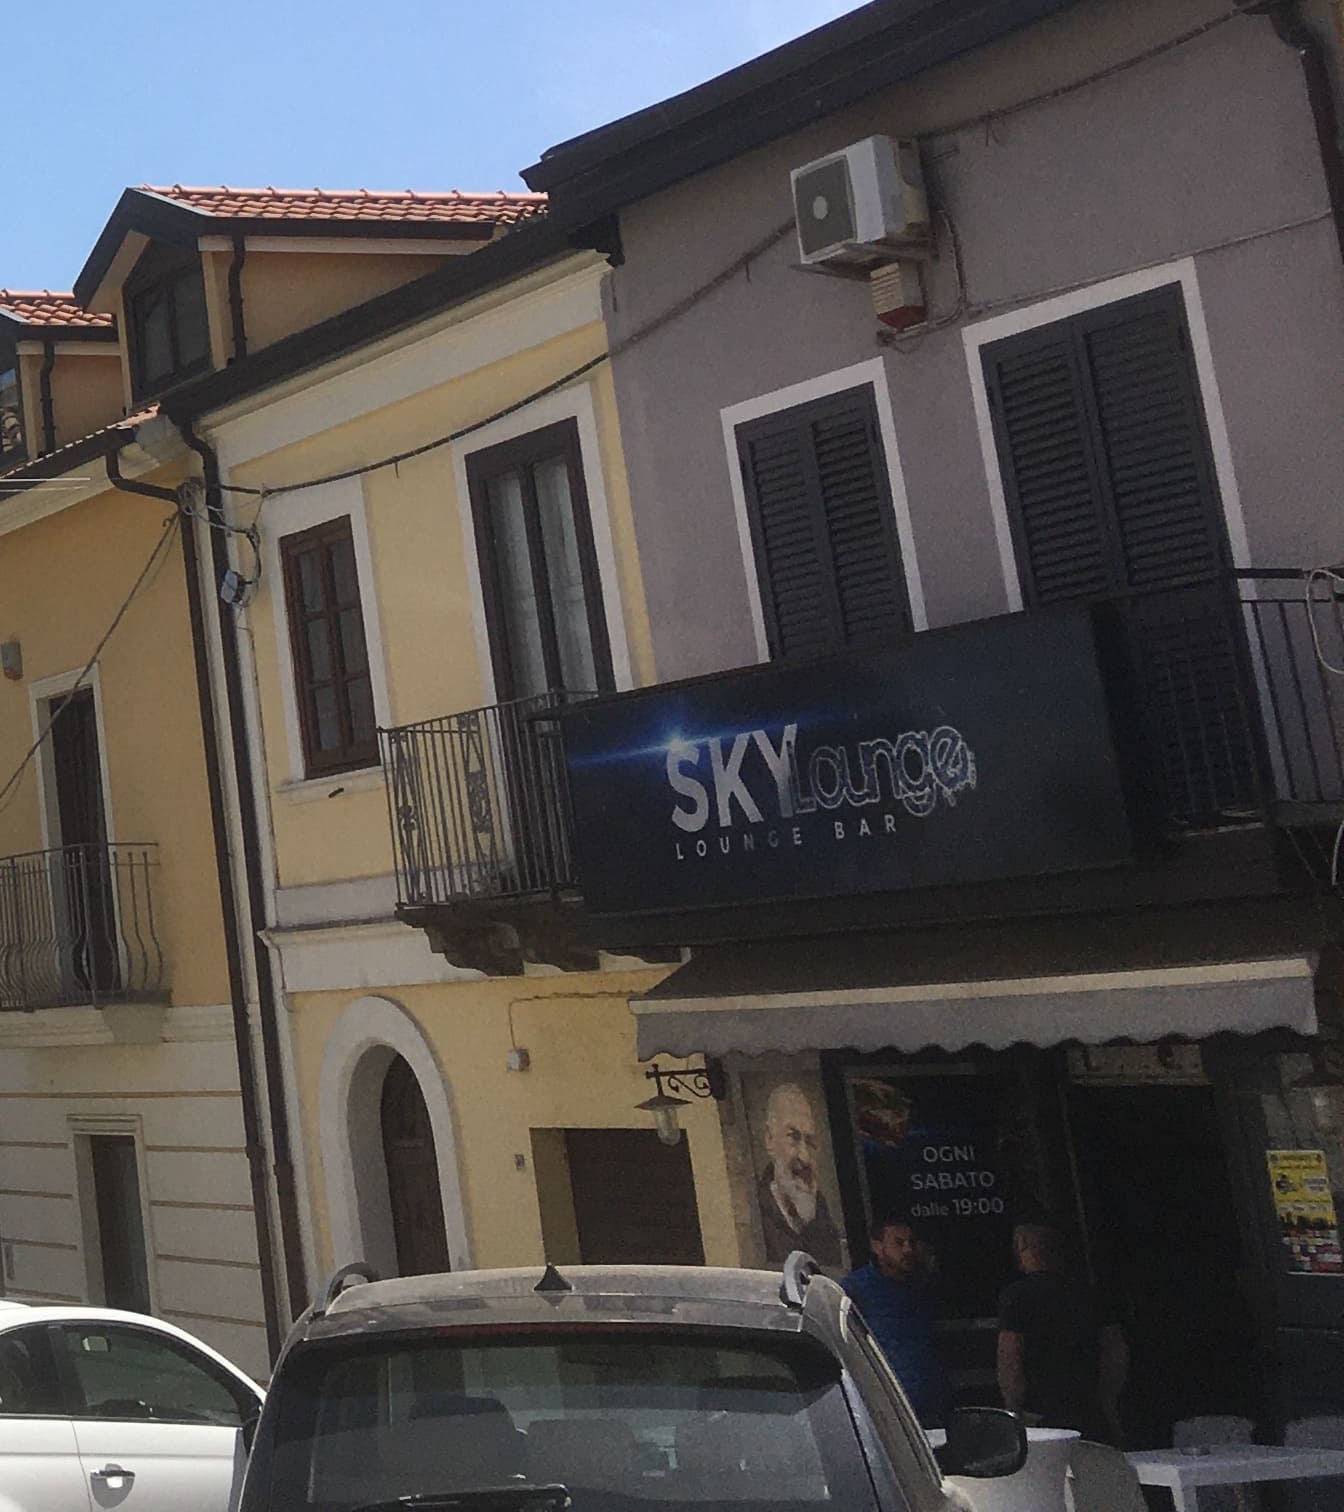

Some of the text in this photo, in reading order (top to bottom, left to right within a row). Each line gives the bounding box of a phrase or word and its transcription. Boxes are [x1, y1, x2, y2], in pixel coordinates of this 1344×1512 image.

[676, 814, 896, 860] LOUNGE BAR
[922, 1146, 976, 1163] OGNI
[911, 1171, 994, 1190] SABATO
[912, 1197, 1004, 1217] dalle 19:00
